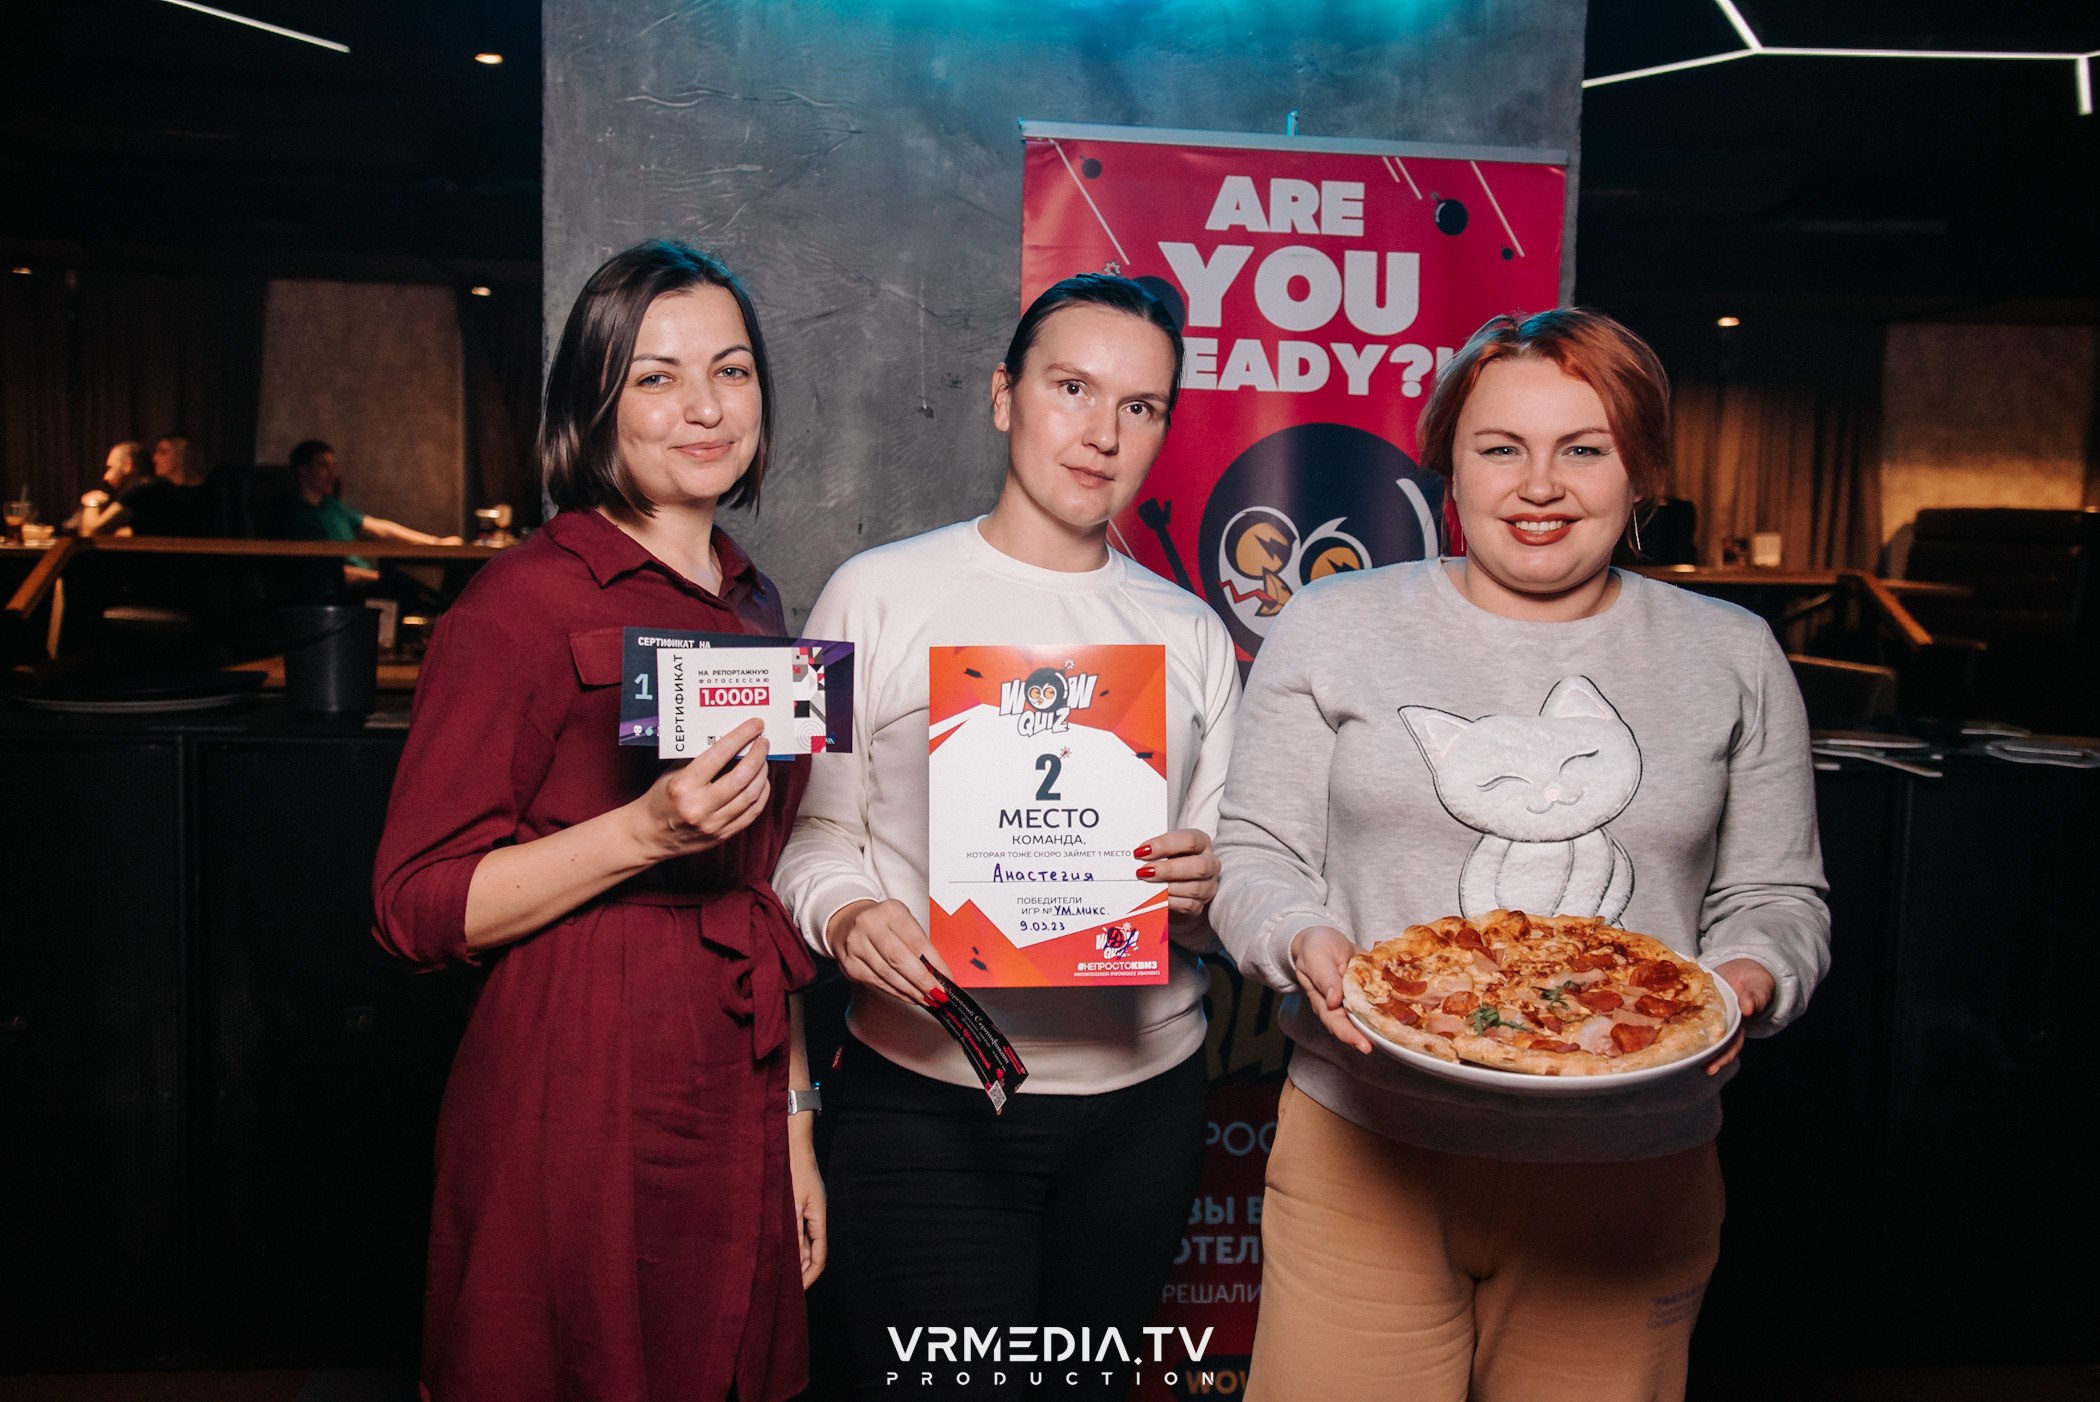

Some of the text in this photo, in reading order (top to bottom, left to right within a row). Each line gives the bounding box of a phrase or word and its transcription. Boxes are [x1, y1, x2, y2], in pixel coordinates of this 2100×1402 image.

[1205, 175, 1365, 236] ARE
[1158, 241, 1420, 335] YOU
[1181, 337, 1454, 398] EADY?
[638, 637, 711, 649] СЕРТИФИКАТ НА
[673, 654, 685, 751] СЕРТИФИКАТ
[1017, 706, 1071, 738] QUIZ
[1035, 753, 1062, 801] 2
[998, 808, 1100, 829] МЕСТО
[1012, 834, 1087, 846] КОМАНДА,
[1033, 850, 1062, 858] СКОРО
[1063, 849, 1096, 858] ЗАЙМЕТ
[1017, 896, 1082, 905] ПОБЕДИТЕЛИ
[1021, 907, 1040, 915] ИГР
[1077, 961, 1158, 971] #НЕПРОСТОКВИЗ
[1161, 1283, 1262, 1304] РЕШАЛИ
